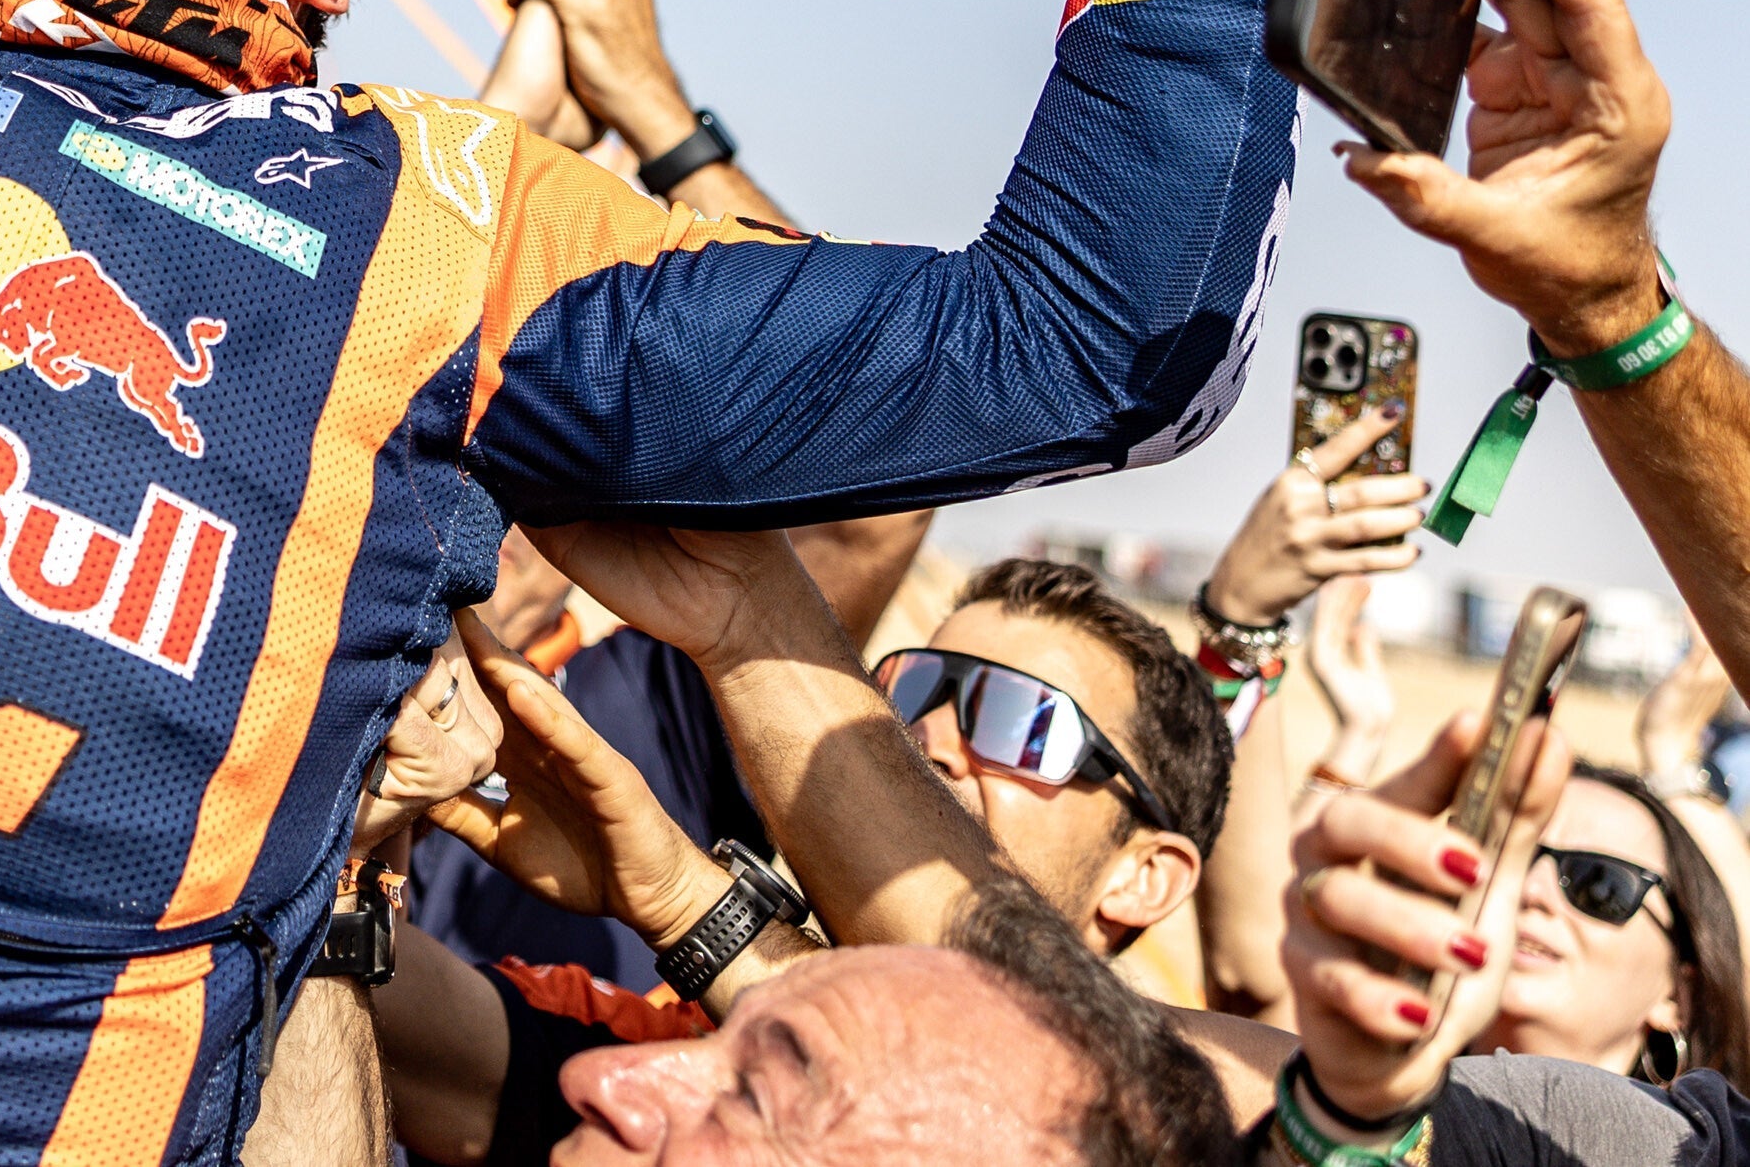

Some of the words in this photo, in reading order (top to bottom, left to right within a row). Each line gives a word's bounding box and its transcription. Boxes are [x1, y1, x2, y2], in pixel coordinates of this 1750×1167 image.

[125, 152, 312, 267] MOTOREX
[1617, 352, 1642, 374] 60
[1636, 339, 1662, 363] 30
